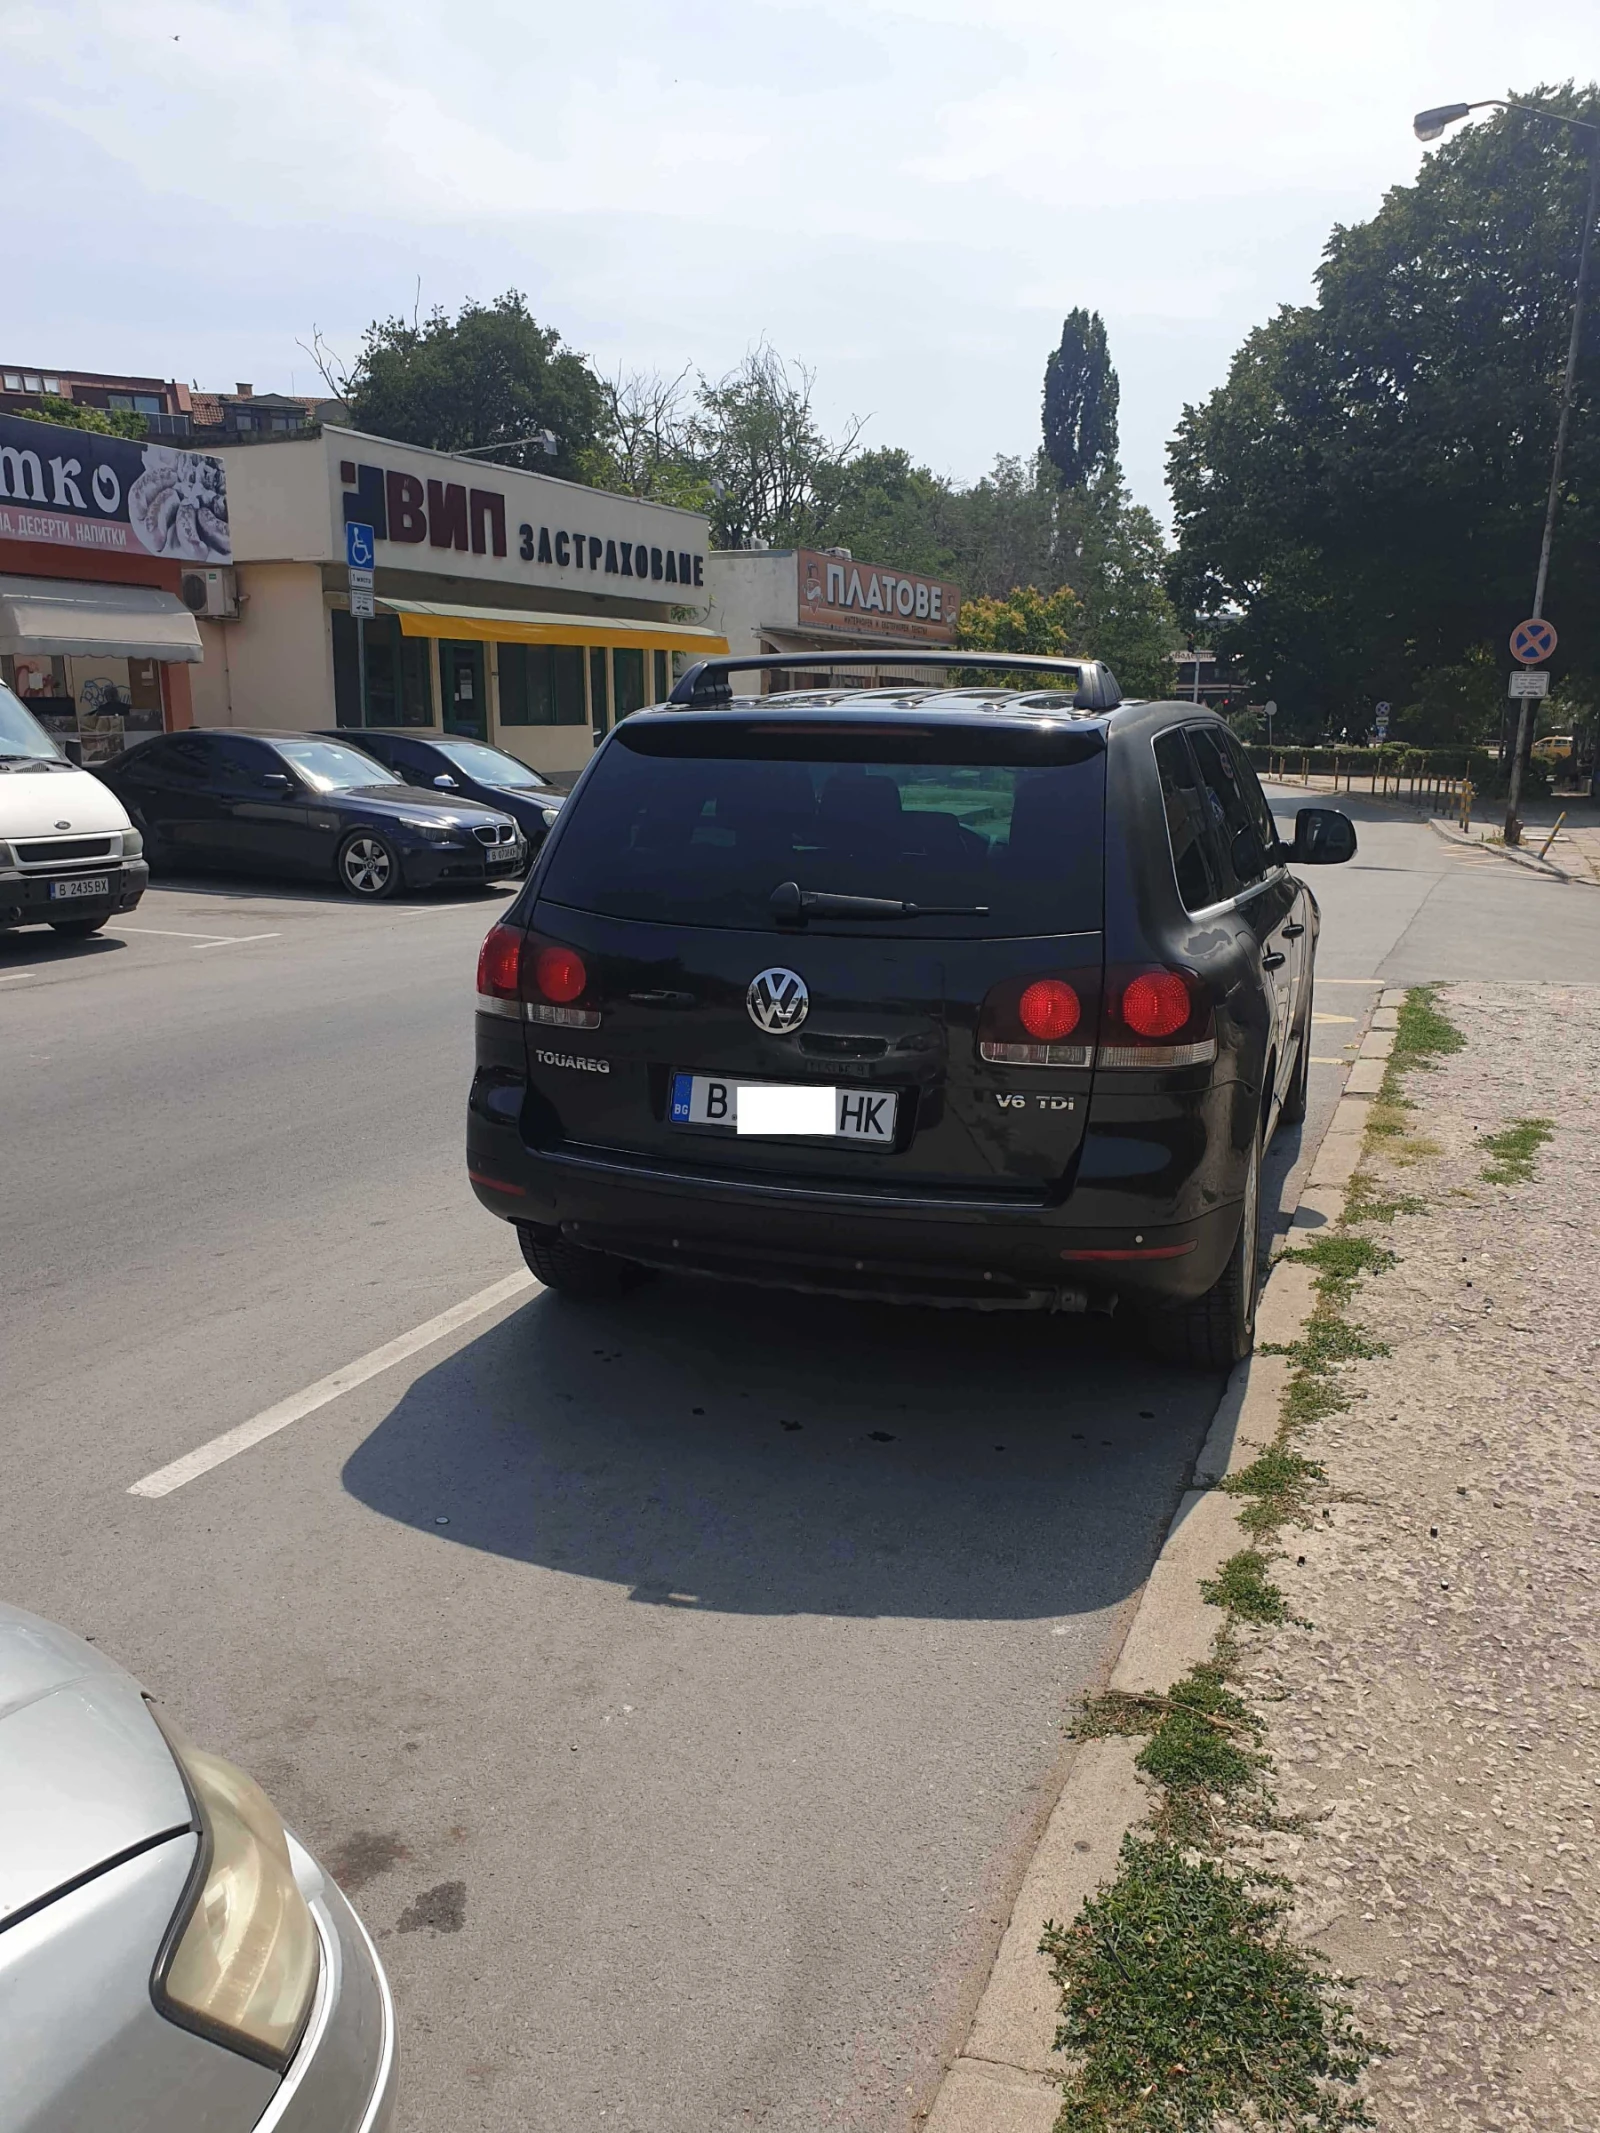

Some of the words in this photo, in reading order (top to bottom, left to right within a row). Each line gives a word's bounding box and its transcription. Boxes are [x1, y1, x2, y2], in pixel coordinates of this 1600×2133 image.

[18, 515, 74, 541] ДЕСЕРТИ,
[76, 523, 127, 546] НАПИТКИ
[386, 470, 507, 557] ВИП
[519, 524, 704, 587] ЗАСТРАХОВАНЕ
[826, 563, 942, 621] ПЛАТОВЕ
[60, 884, 66, 896] B
[535, 1049, 610, 1074] TOUAREG
[674, 1103, 689, 1115] BG
[840, 1094, 887, 1135] HK
[995, 1094, 1026, 1108] V6
[1035, 1095, 1074, 1111] TDI
